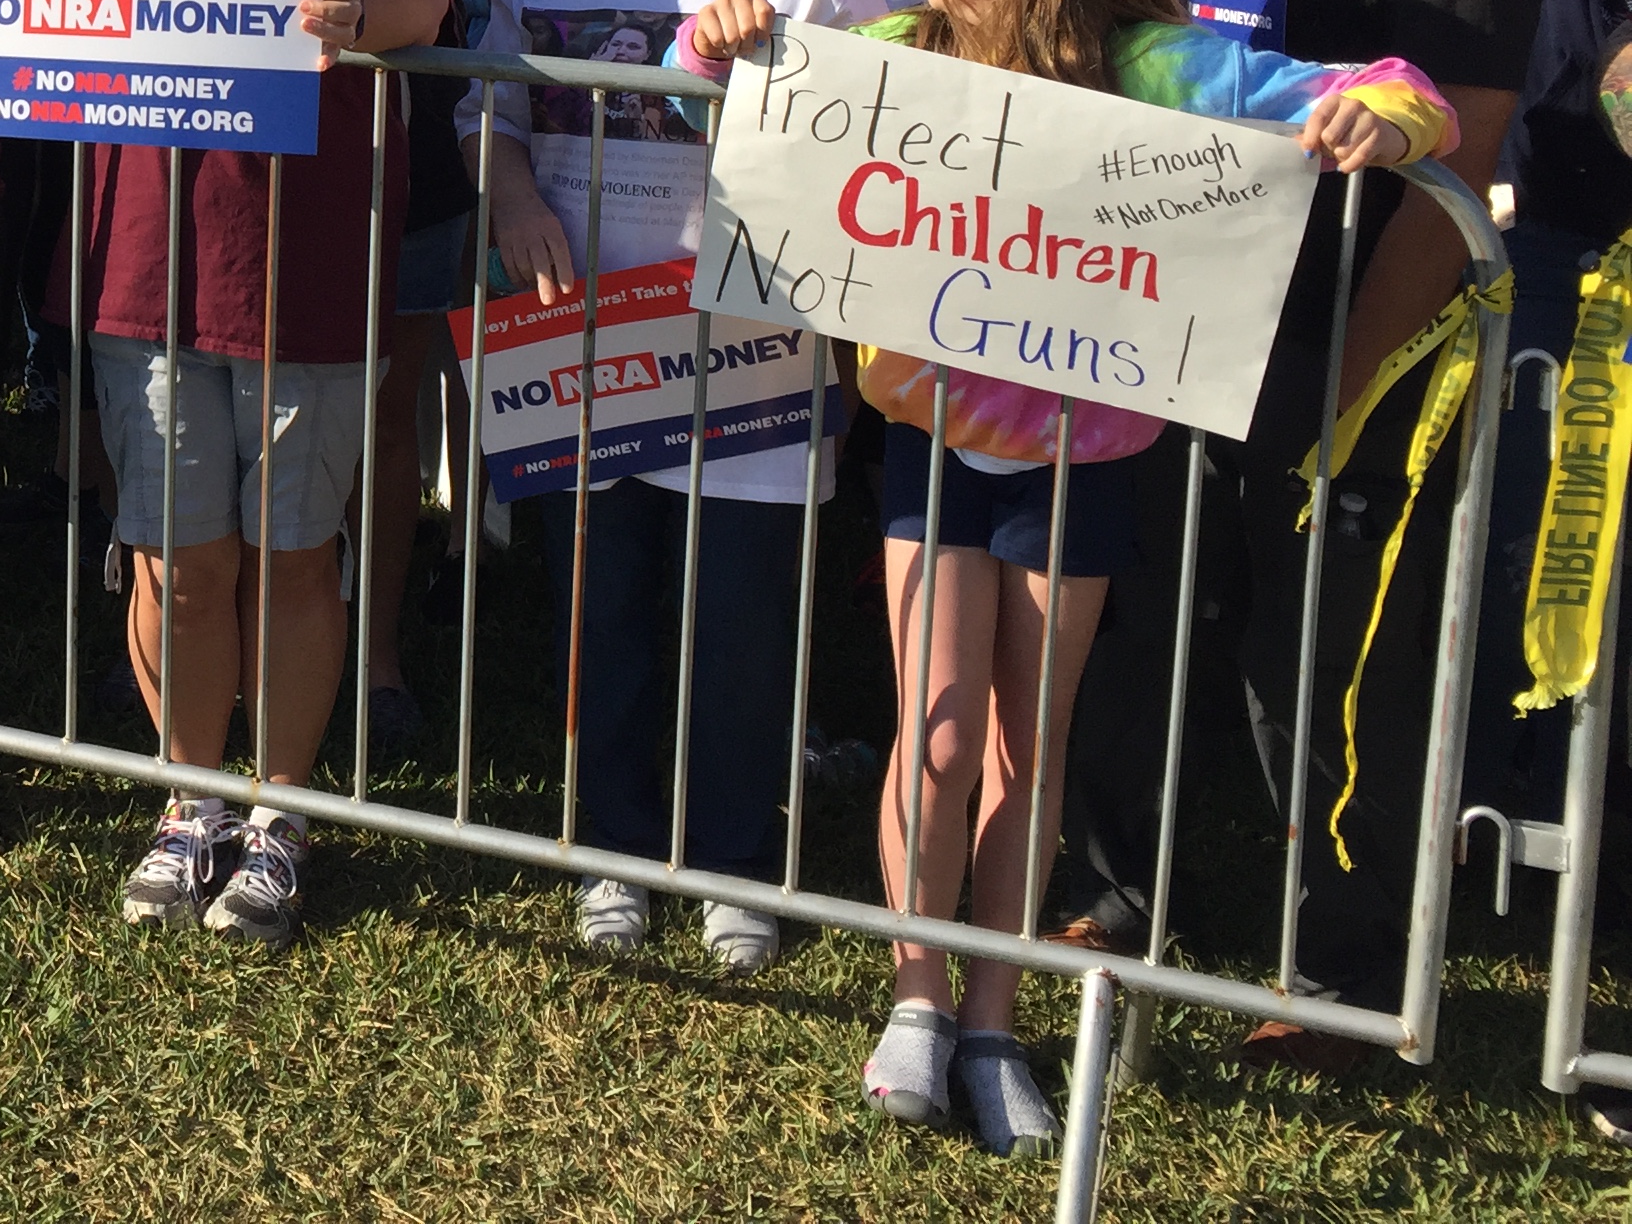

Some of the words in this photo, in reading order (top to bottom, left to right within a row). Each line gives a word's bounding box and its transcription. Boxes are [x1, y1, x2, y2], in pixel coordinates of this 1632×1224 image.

[12, 66, 235, 101] #NONRAMONEY
[759, 33, 1024, 191] Protect
[1096, 132, 1245, 183] #Enough
[601, 181, 673, 199] VIOLENCE
[837, 160, 1161, 302] Children
[715, 217, 873, 324] Not
[632, 283, 678, 302] Take
[491, 380, 552, 415] NO
